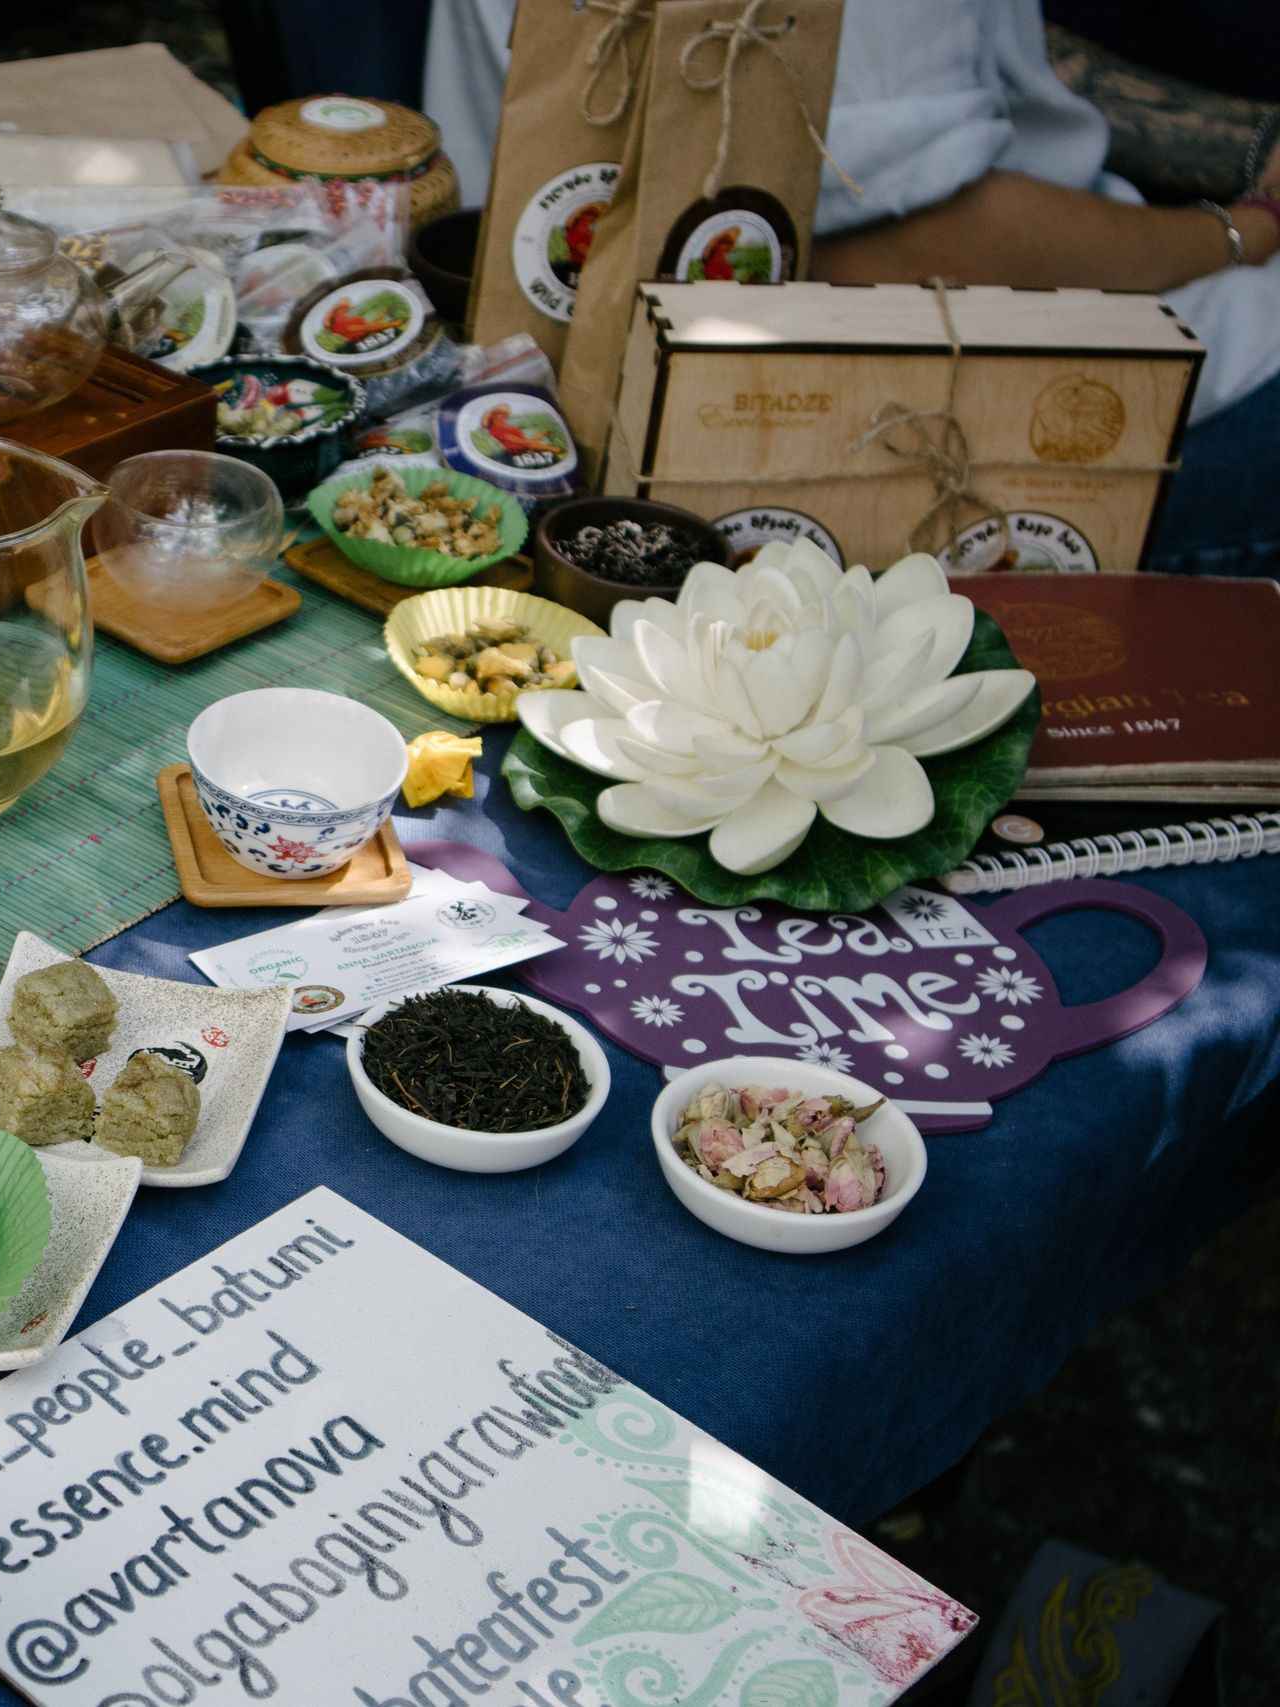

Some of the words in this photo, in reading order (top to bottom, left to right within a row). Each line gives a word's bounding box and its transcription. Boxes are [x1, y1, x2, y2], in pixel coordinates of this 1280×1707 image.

[733, 393, 833, 413] BITADZE
[512, 450, 554, 468] 1847
[1041, 692, 1152, 719] rgian
[1123, 717, 1180, 734] 1847
[676, 906, 914, 964] Tea
[919, 925, 983, 942] TEA
[247, 949, 294, 966] GEORGIAN
[337, 957, 376, 972] ANNA
[372, 936, 440, 962] VARTANOVA
[362, 956, 391, 970] Project
[390, 949, 425, 963] Manager
[249, 956, 304, 974] ORGANIC
[96, 1329, 627, 1707] olgaboginyarawfood
[6, 1414, 387, 1687] @avartanova
